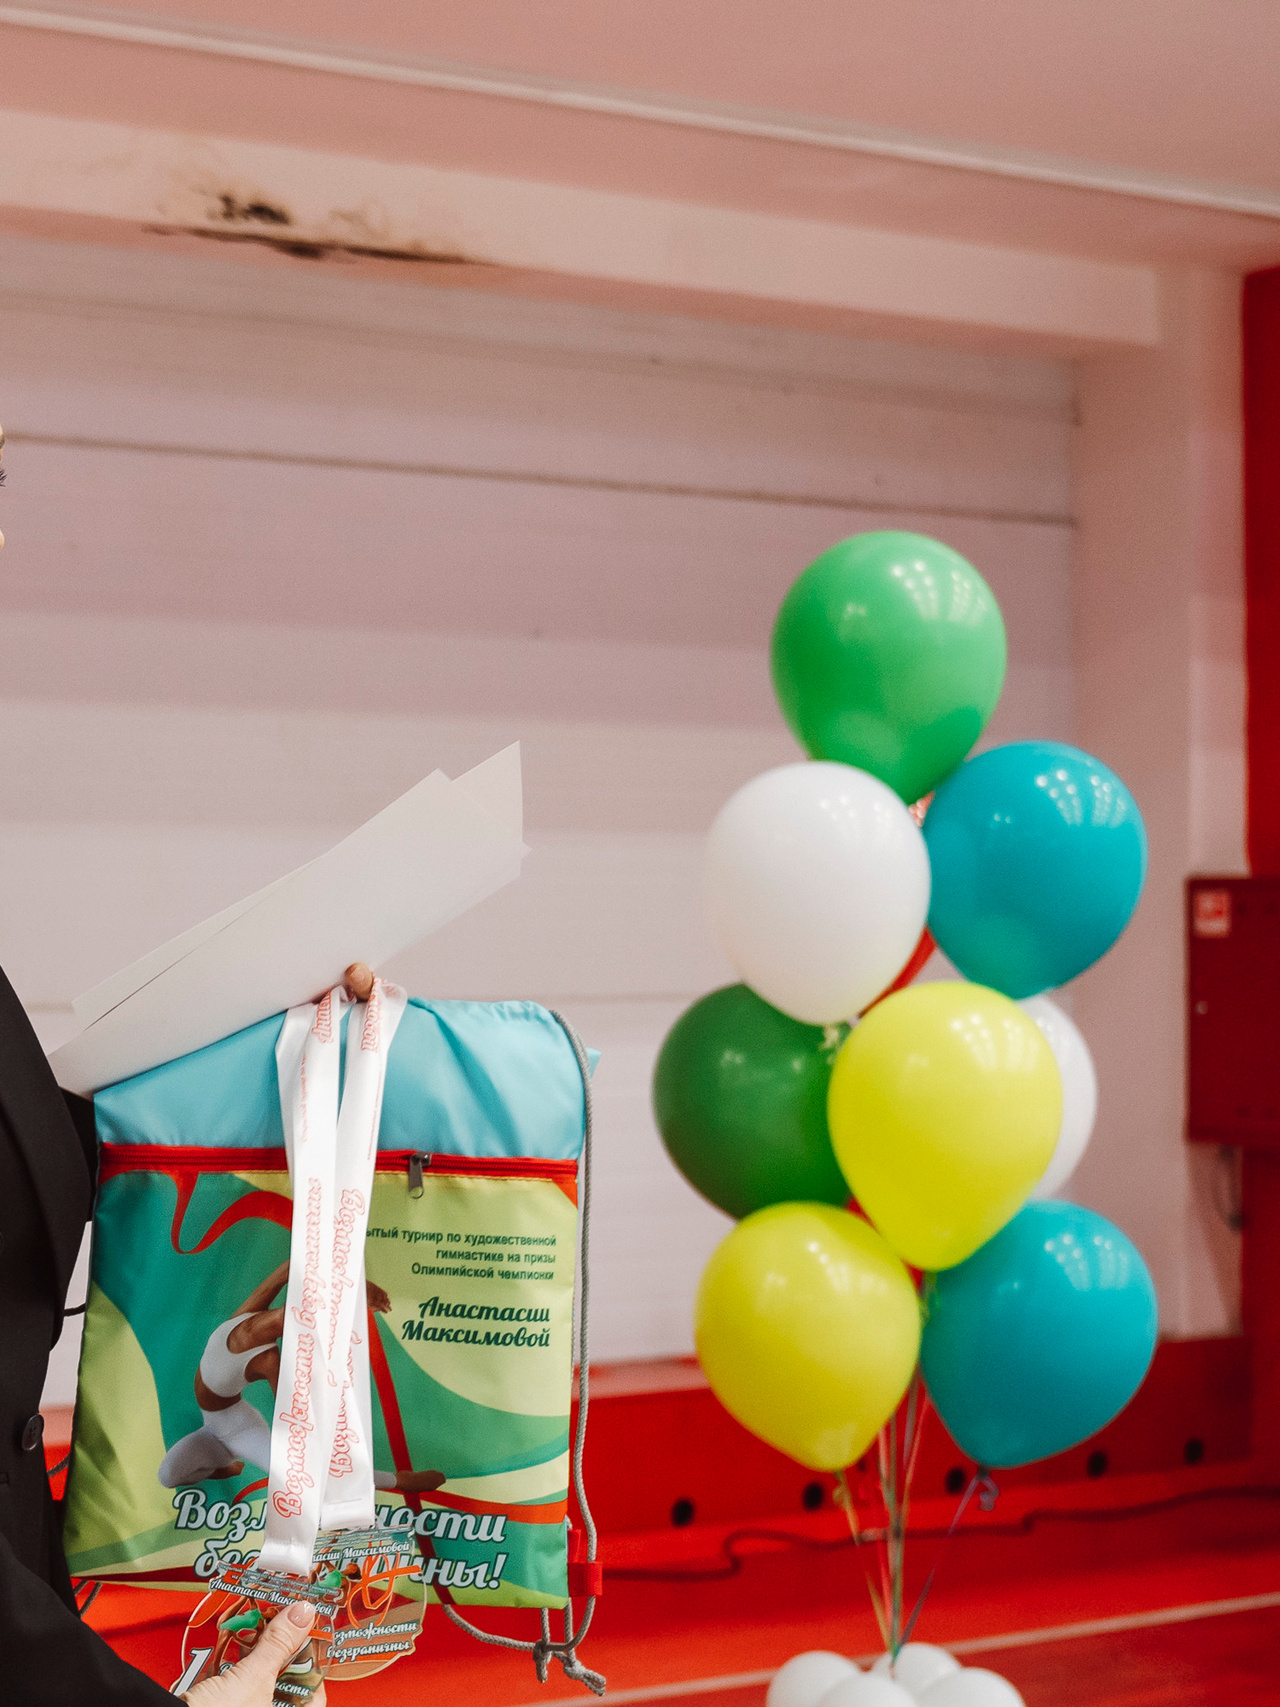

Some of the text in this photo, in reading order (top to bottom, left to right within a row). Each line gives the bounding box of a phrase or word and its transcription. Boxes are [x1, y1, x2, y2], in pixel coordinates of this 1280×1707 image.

[366, 1227, 557, 1247] ытый турнир по художественной
[436, 1249, 556, 1266] гимнастике на призы
[411, 1262, 554, 1281] Олимпийской чемпионки
[418, 1296, 550, 1323] Анастасии
[401, 1320, 551, 1348] Максимовой
[273, 1332, 315, 1518] Возможности
[342, 1541, 410, 1559] Максимовой
[210, 1579, 268, 1599] Анастасии
